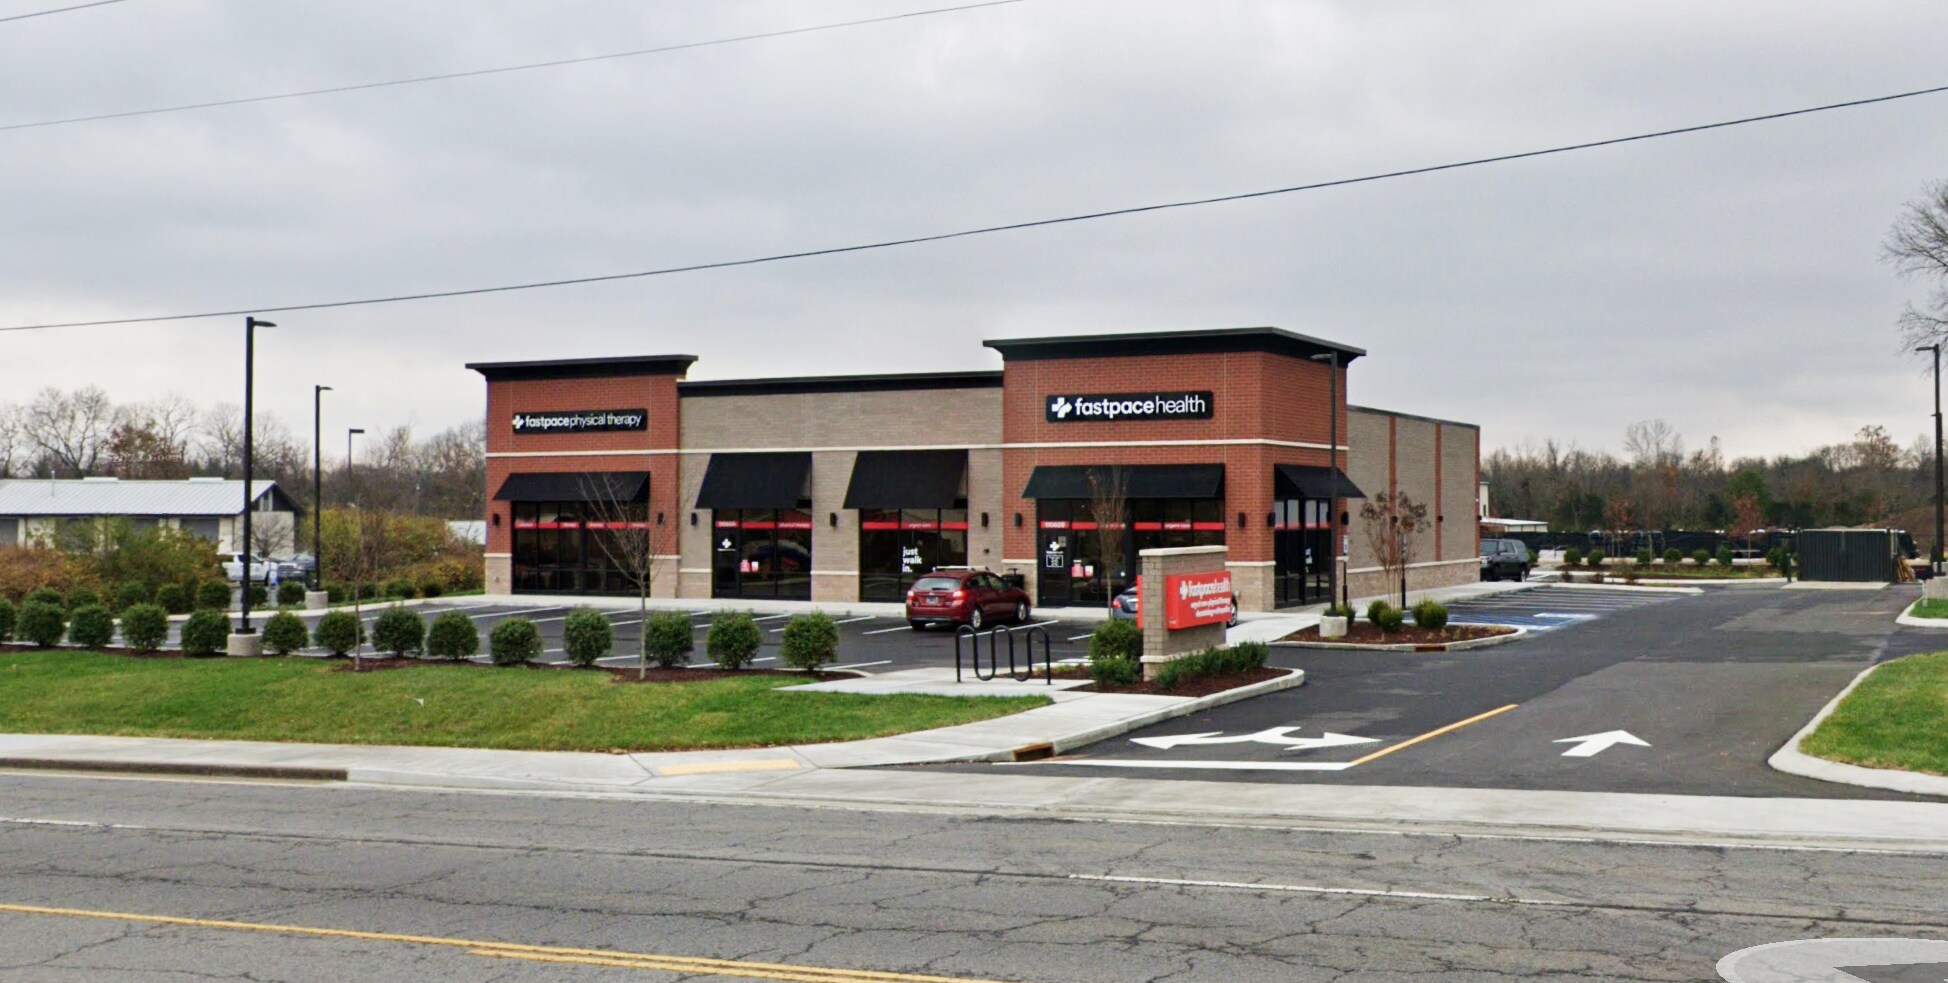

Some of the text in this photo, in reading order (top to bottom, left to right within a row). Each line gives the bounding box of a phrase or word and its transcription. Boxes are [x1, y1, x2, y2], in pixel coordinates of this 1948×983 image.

[607, 413, 642, 426] therapy
[903, 546, 918, 556] just
[902, 556, 922, 564] walk
[902, 564, 913, 573] in.
